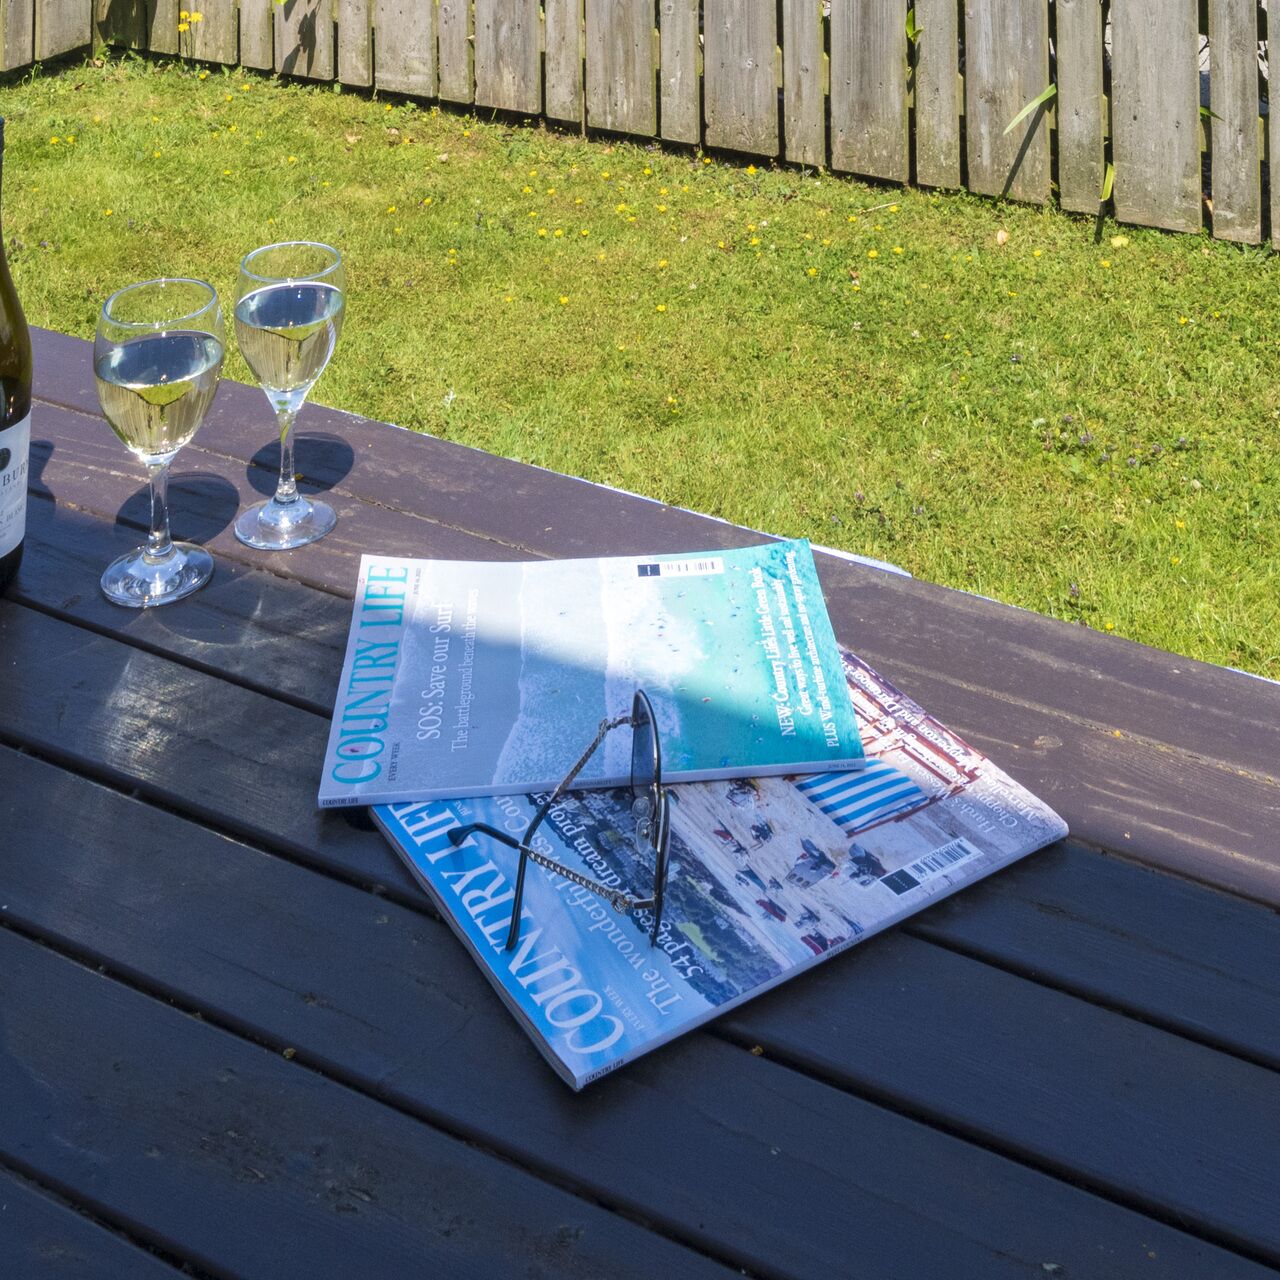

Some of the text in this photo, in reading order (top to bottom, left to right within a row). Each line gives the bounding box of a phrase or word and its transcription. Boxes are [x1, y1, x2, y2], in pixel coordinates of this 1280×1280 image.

[748, 567, 765, 588] Book
[756, 590, 770, 614] Green
[797, 613, 810, 625] and
[758, 615, 775, 637] Little
[779, 615, 793, 628] and
[332, 565, 408, 784] COUNTRY LIFE
[416, 602, 454, 740] SOS: Save our Surf
[451, 589, 479, 752] The battleground beneath the waves
[772, 661, 789, 701] Country
[796, 670, 809, 689] ways
[796, 691, 813, 716] Great
[846, 667, 902, 713] Dartmoor's
[776, 702, 796, 736] NEW:
[823, 722, 839, 747] PLUS
[893, 709, 922, 727] and
[388, 741, 401, 781] EVERY WEEK
[918, 725, 979, 773] Mapperton
[912, 765, 951, 800] Wessex:
[973, 772, 1035, 821] Marvellous
[322, 798, 346, 806] COUNTRY
[950, 798, 997, 833] Hardy's
[977, 791, 1018, 828] Choppy
[573, 838, 623, 889] dream
[556, 880, 646, 970] wonderful
[632, 907, 687, 956] pages
[442, 860, 624, 1054] COUNTRY
[669, 954, 705, 981] 54
[602, 984, 644, 1030] EVERY WEEK
[642, 970, 685, 1016] The
[585, 1058, 625, 1083] COUNTRY LIFE
